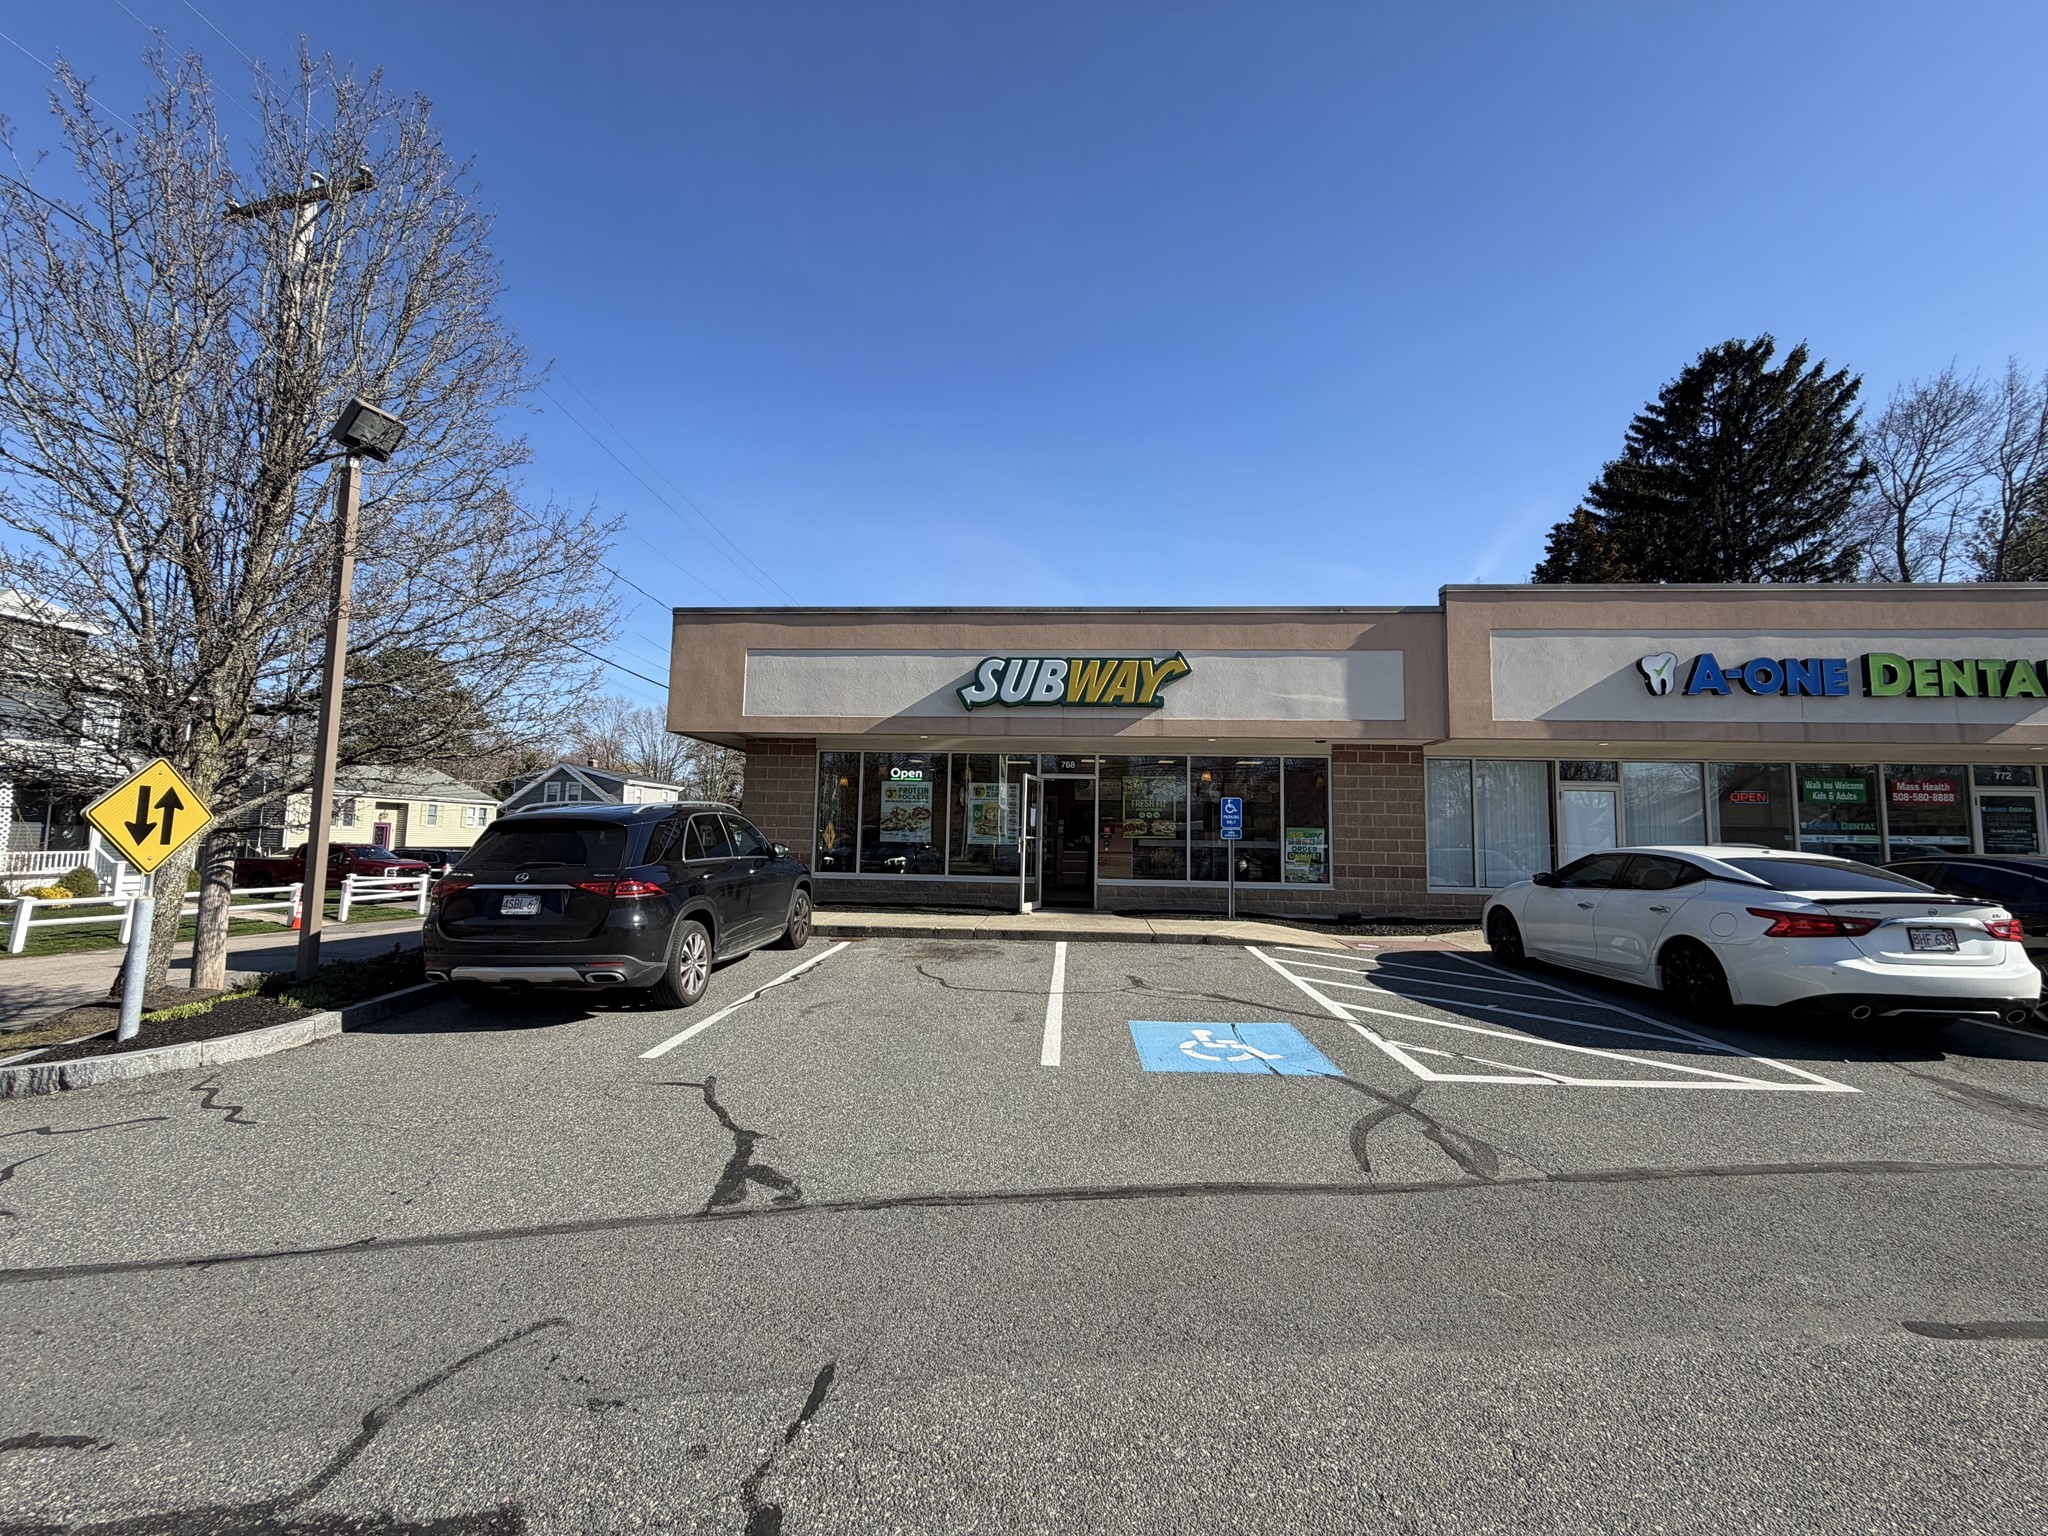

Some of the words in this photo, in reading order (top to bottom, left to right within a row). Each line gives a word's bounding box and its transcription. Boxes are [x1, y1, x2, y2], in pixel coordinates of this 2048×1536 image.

[1683, 652, 1849, 696] A-ONE
[1864, 652, 2048, 698] DENTA
[960, 655, 1188, 705] SUBWAY
[1061, 760, 1076, 769] 768
[890, 767, 923, 780] Open
[1994, 771, 2012, 780] 772
[1804, 780, 1821, 789] Walk
[1823, 781, 1833, 789] Ins
[1835, 781, 1864, 790] Welcome
[1896, 782, 1920, 791] Mass
[1922, 782, 1950, 791] Health
[898, 787, 930, 795] PROTEIN
[1812, 791, 1827, 800] Kids
[1836, 792, 1858, 800] Adults
[1730, 792, 1767, 801] OPEN
[1892, 792, 1955, 802] 508-580-8888
[1131, 799, 1155, 808] FRESH
[1156, 799, 1167, 808] FIT
[1840, 821, 1876, 831] DENTAL
[502, 898, 523, 910] 4SBL
